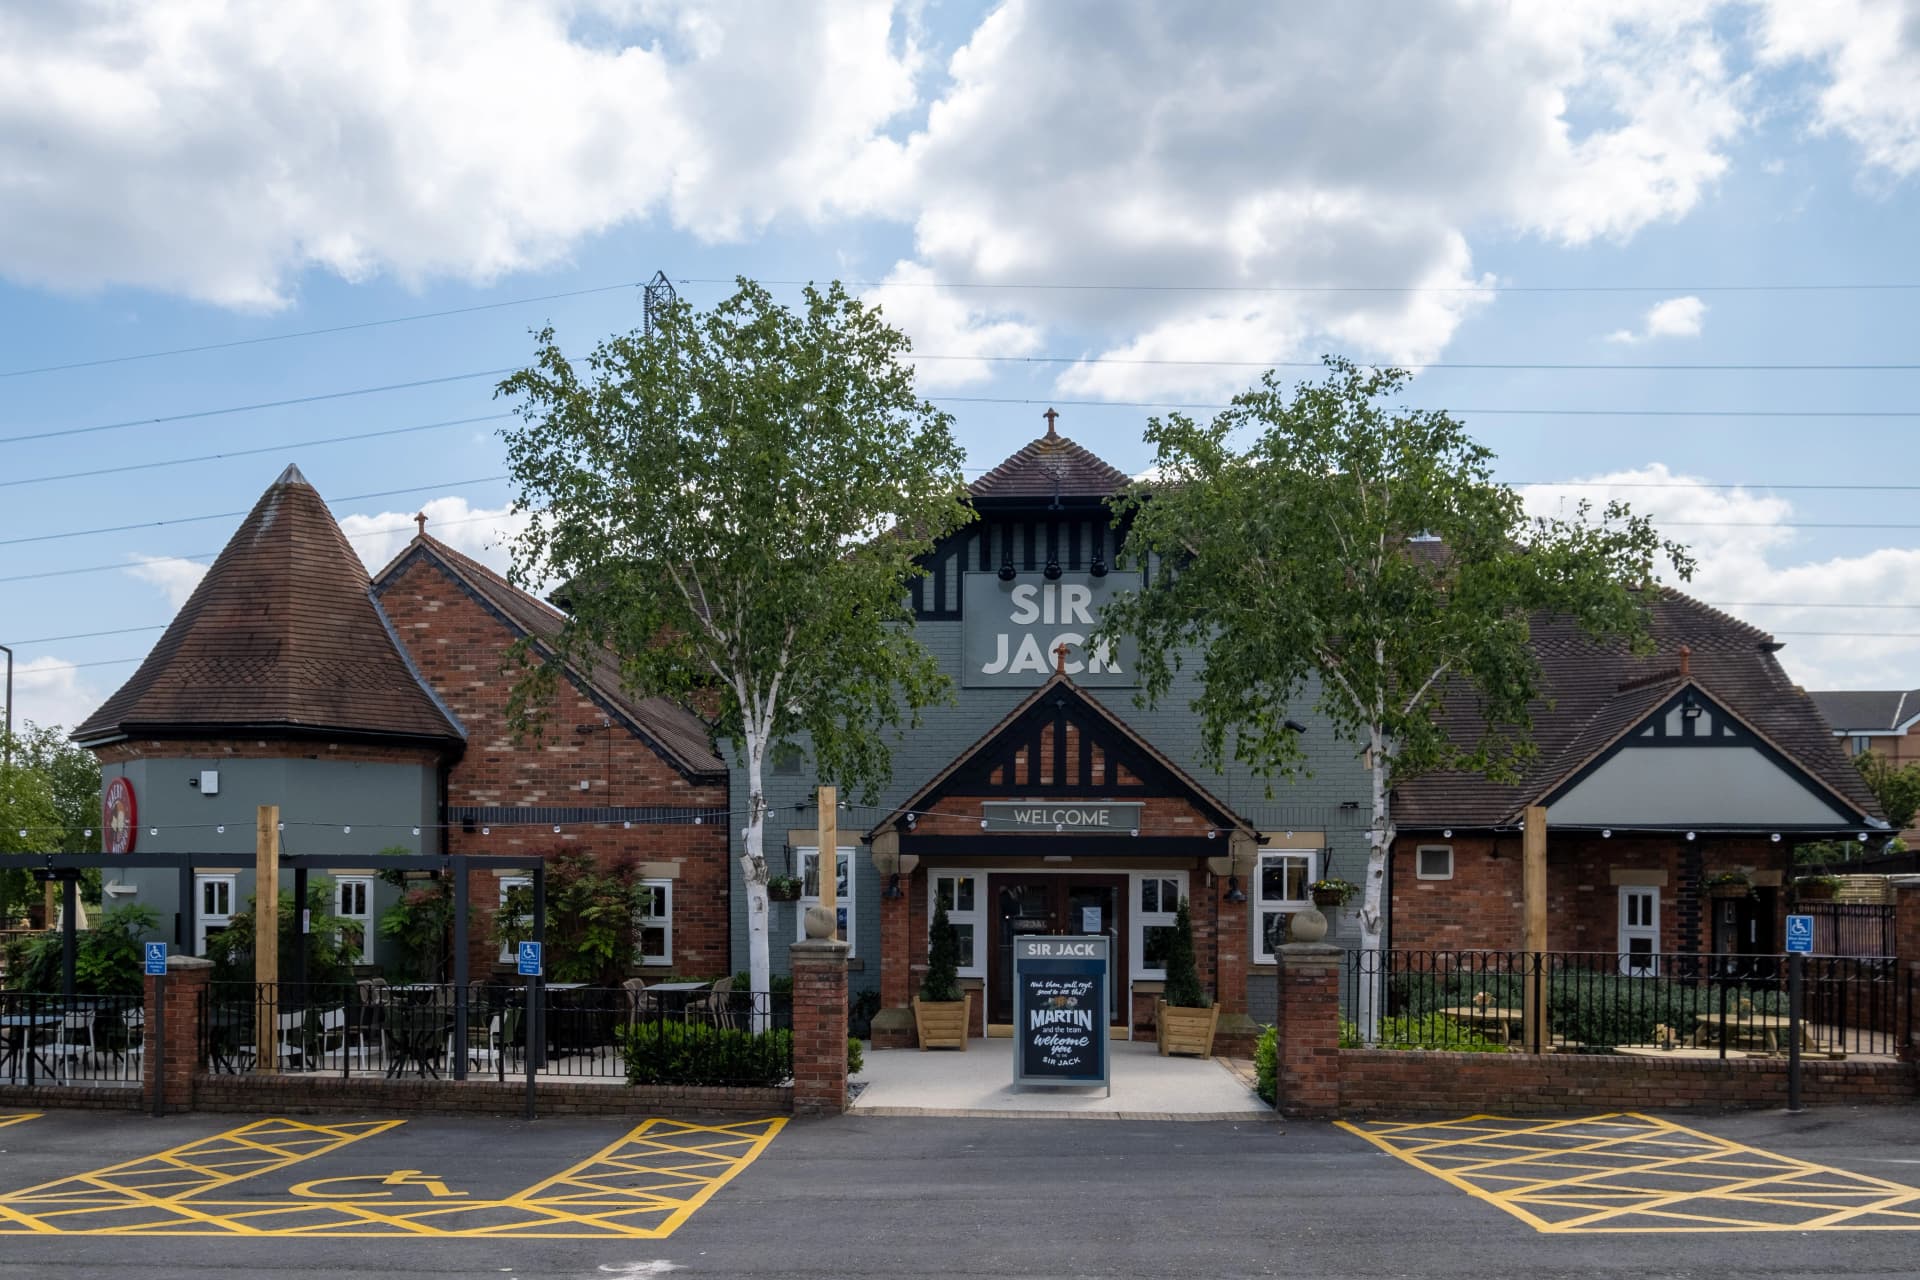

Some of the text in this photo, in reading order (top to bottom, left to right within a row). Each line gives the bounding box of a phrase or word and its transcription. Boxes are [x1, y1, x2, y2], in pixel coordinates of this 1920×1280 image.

[1010, 584, 1095, 625] SIR
[982, 633, 1123, 675] JACK
[1014, 809, 1110, 825] WELCOME
[1028, 944, 1095, 956] SIR JACK
[1030, 1009, 1092, 1031] MARTIN
[1033, 1034, 1090, 1047] welcome
[1051, 1045, 1072, 1055] you
[1042, 1056, 1081, 1066] SIR JACK
